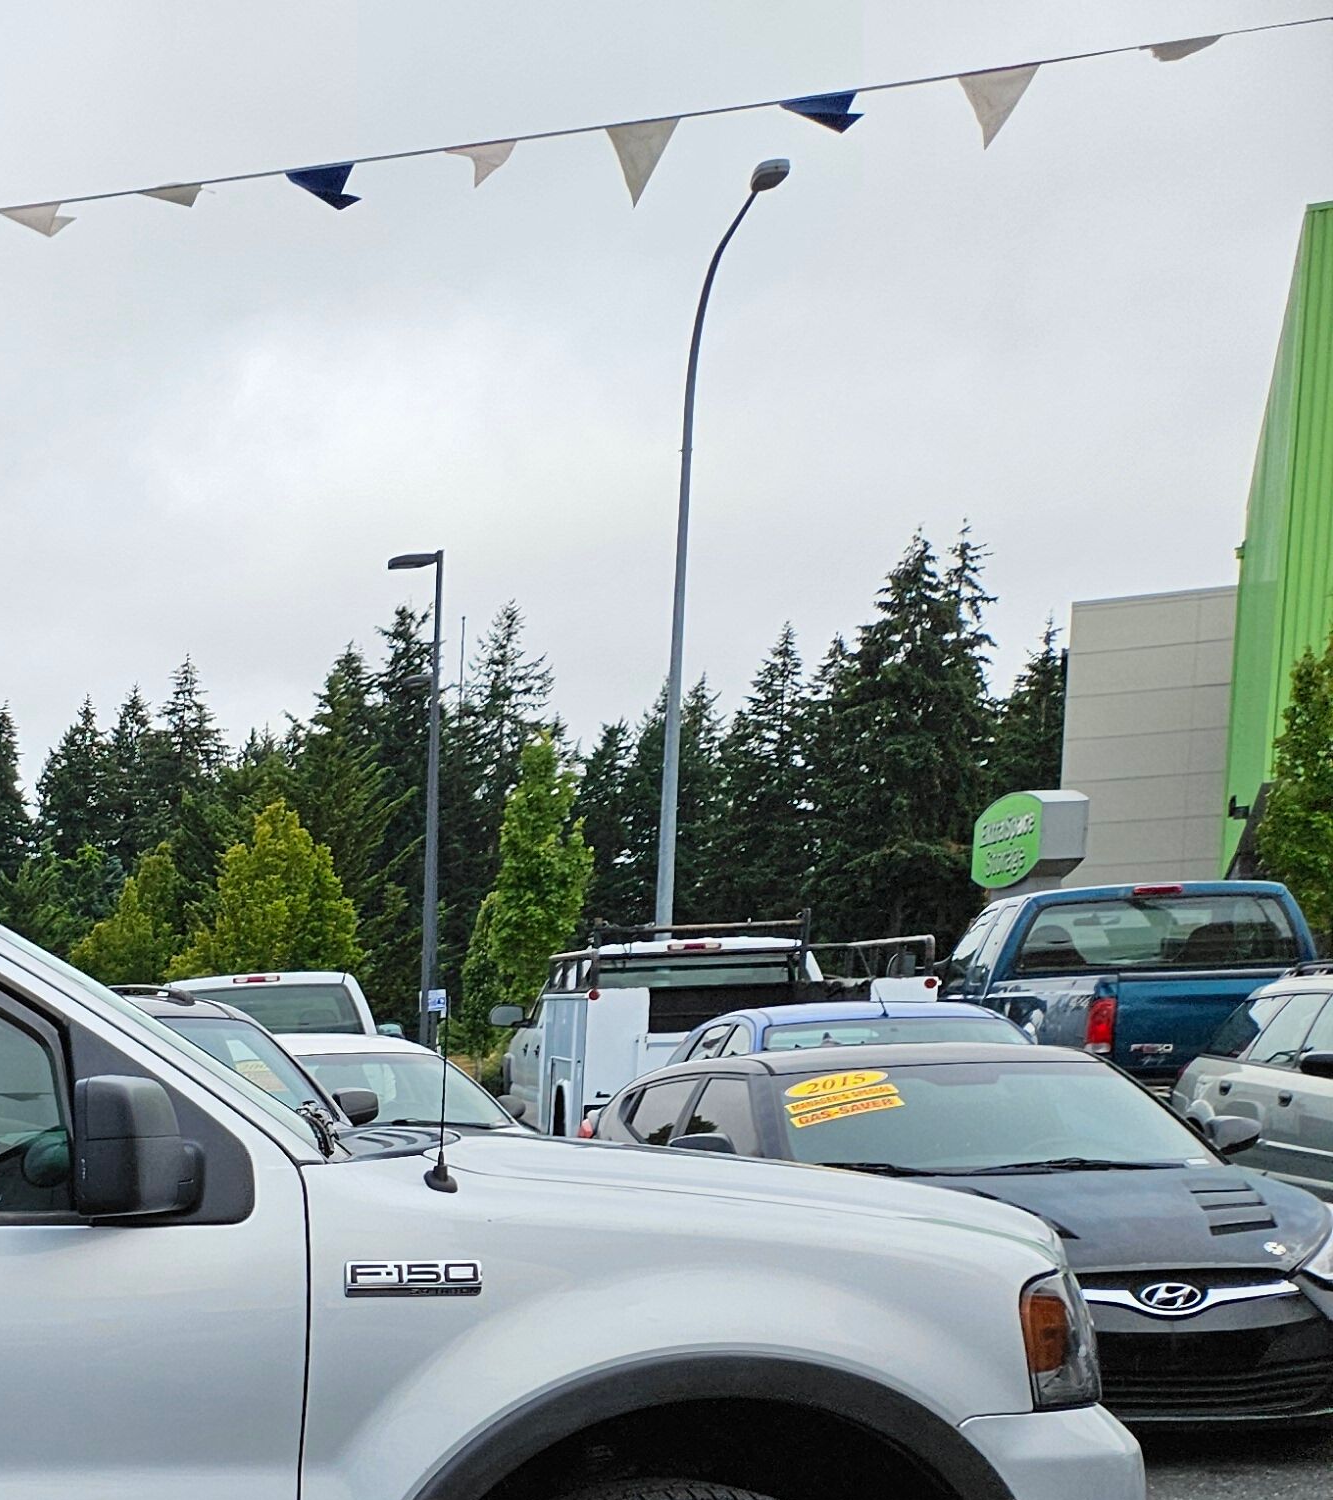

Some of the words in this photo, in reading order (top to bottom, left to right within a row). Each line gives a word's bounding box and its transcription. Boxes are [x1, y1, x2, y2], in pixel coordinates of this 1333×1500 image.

[986, 846, 1025, 878] Storage
[806, 1073, 866, 1094] 2015
[798, 1098, 894, 1125] GAS-SAVER
[350, 1263, 479, 1284] F-150
